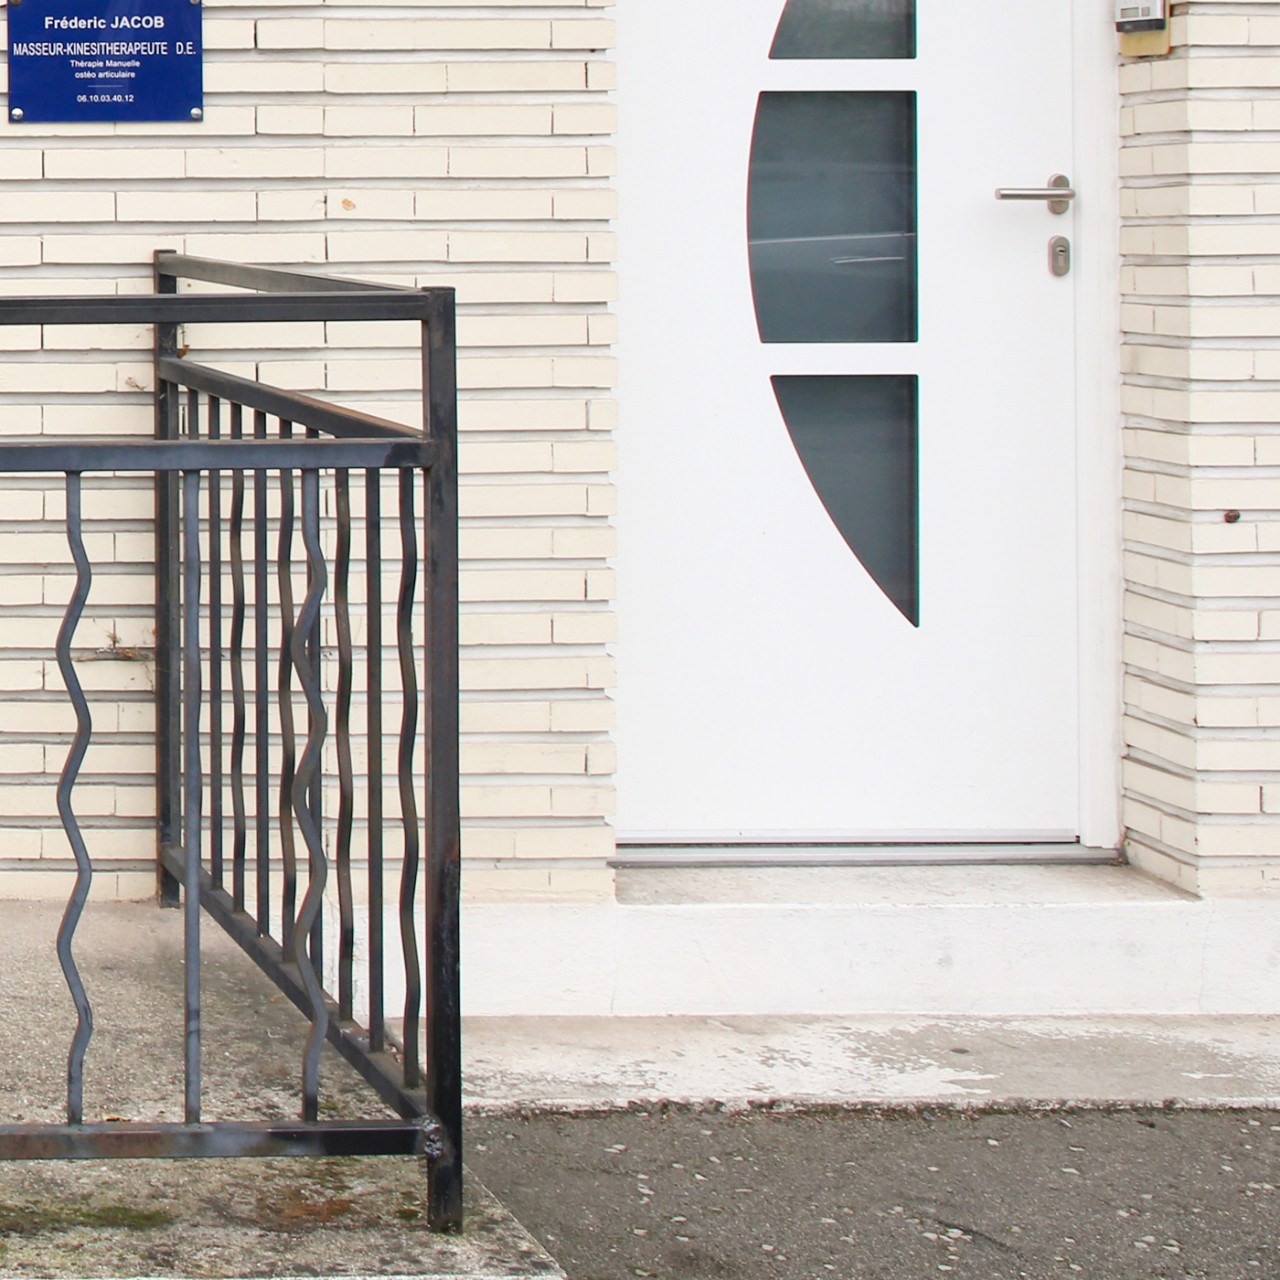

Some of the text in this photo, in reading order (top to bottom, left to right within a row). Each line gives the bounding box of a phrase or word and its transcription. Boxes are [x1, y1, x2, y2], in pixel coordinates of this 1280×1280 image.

[44, 15, 165, 30] Fréderic JACOB
[12, 41, 197, 57] MASSEUR-KINESITHERAPEUTE D.E.
[69, 59, 141, 68] Thérapie Manuelle
[74, 70, 137, 79] ostéo articulaire
[76, 93, 135, 103] 06.10.03.40.12
